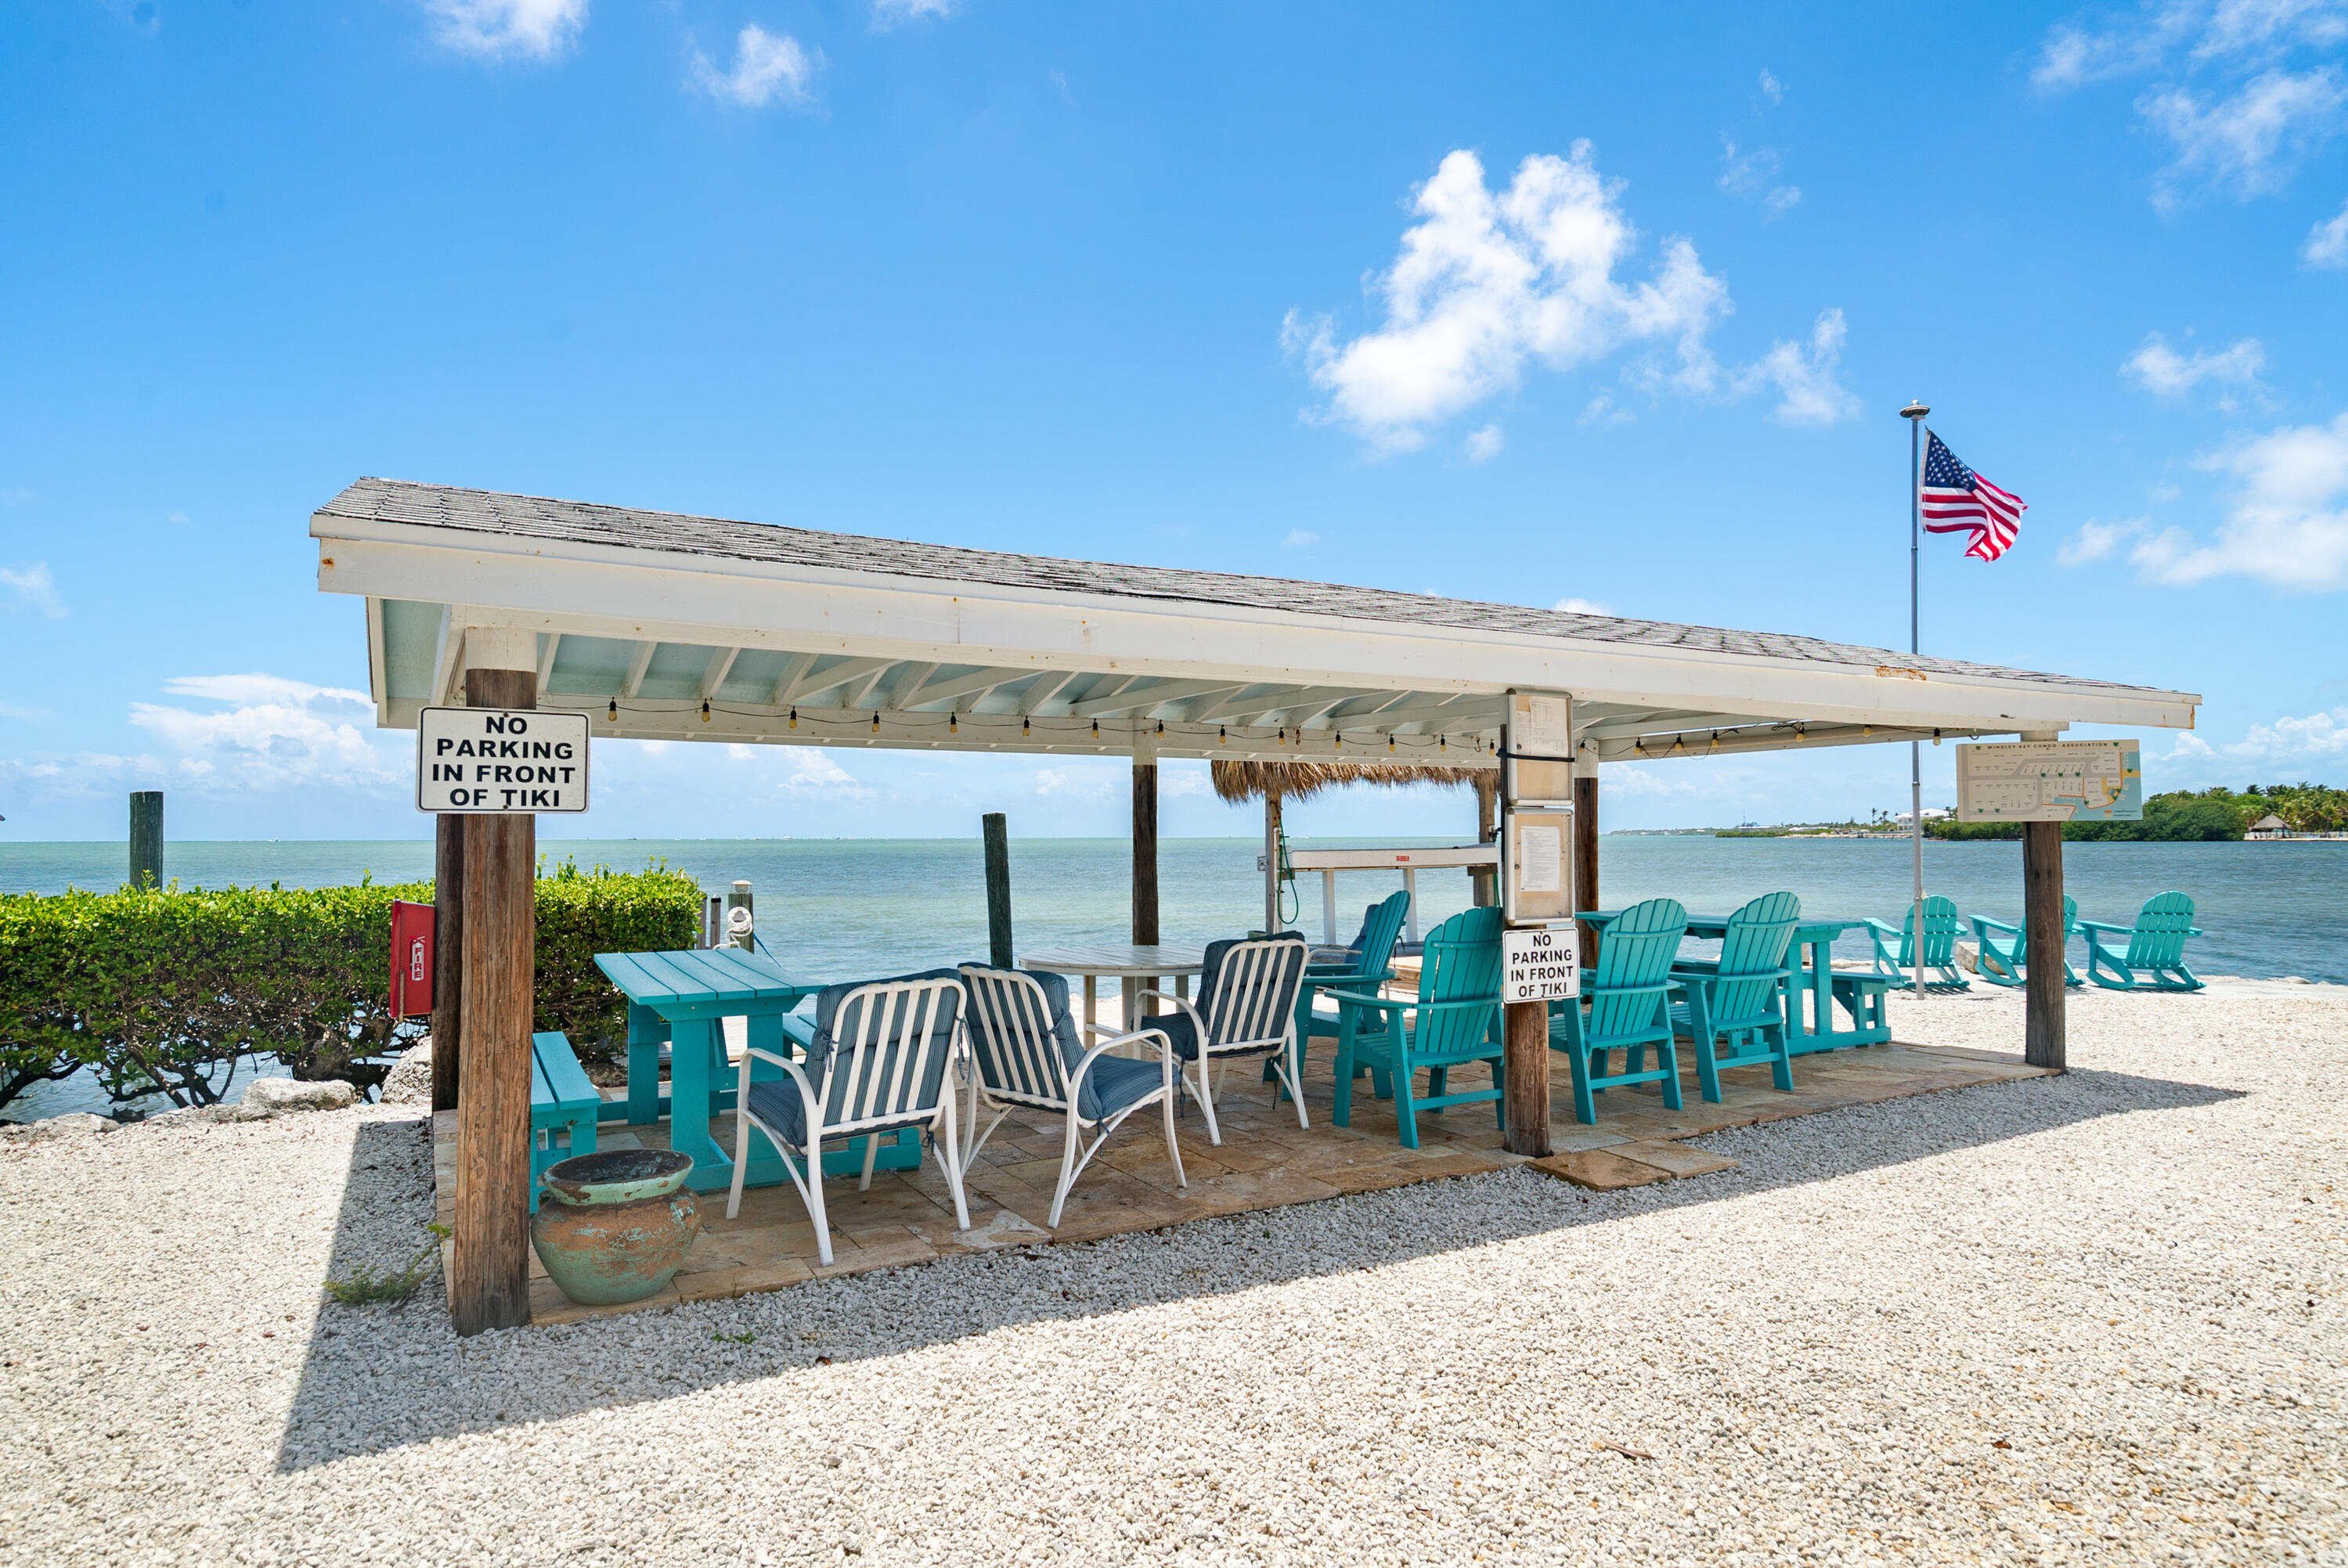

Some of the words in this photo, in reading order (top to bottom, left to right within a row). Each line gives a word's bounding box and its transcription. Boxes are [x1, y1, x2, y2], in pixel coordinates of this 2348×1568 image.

[486, 716, 527, 734] NO
[437, 738, 572, 759] PARKING
[433, 764, 463, 781] IN
[477, 765, 575, 784] FRONT
[449, 788, 488, 806] OF
[500, 789, 559, 807] TIKI
[1533, 934, 1551, 946] NO
[1513, 949, 1572, 964] PARKING
[1511, 969, 1524, 982] IN
[1530, 965, 1573, 980] FRONT
[1519, 985, 1535, 997] OF
[1540, 982, 1567, 996] TIKI
